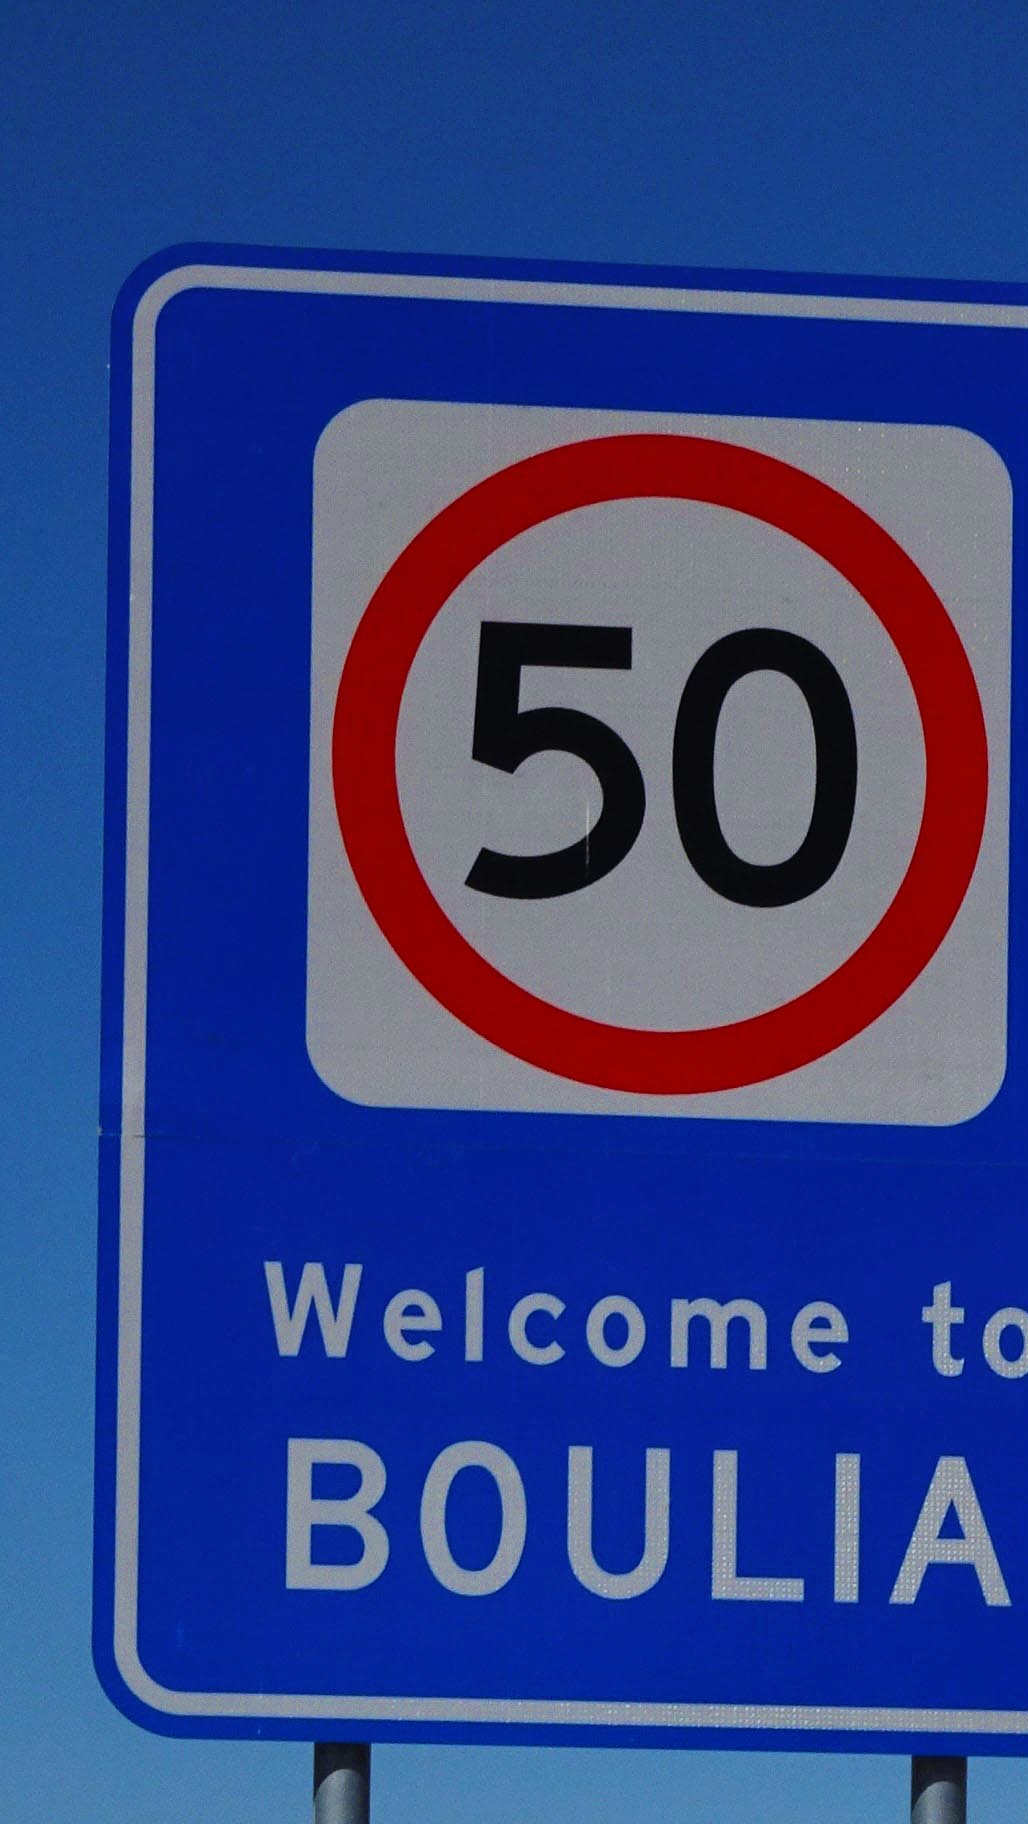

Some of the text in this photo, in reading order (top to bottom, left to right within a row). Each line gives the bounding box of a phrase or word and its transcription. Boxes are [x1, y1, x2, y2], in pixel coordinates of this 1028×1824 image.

[464, 621, 858, 909] 50
[264, 1261, 849, 1373] Welcome
[285, 1438, 1012, 1607] BOULIA
